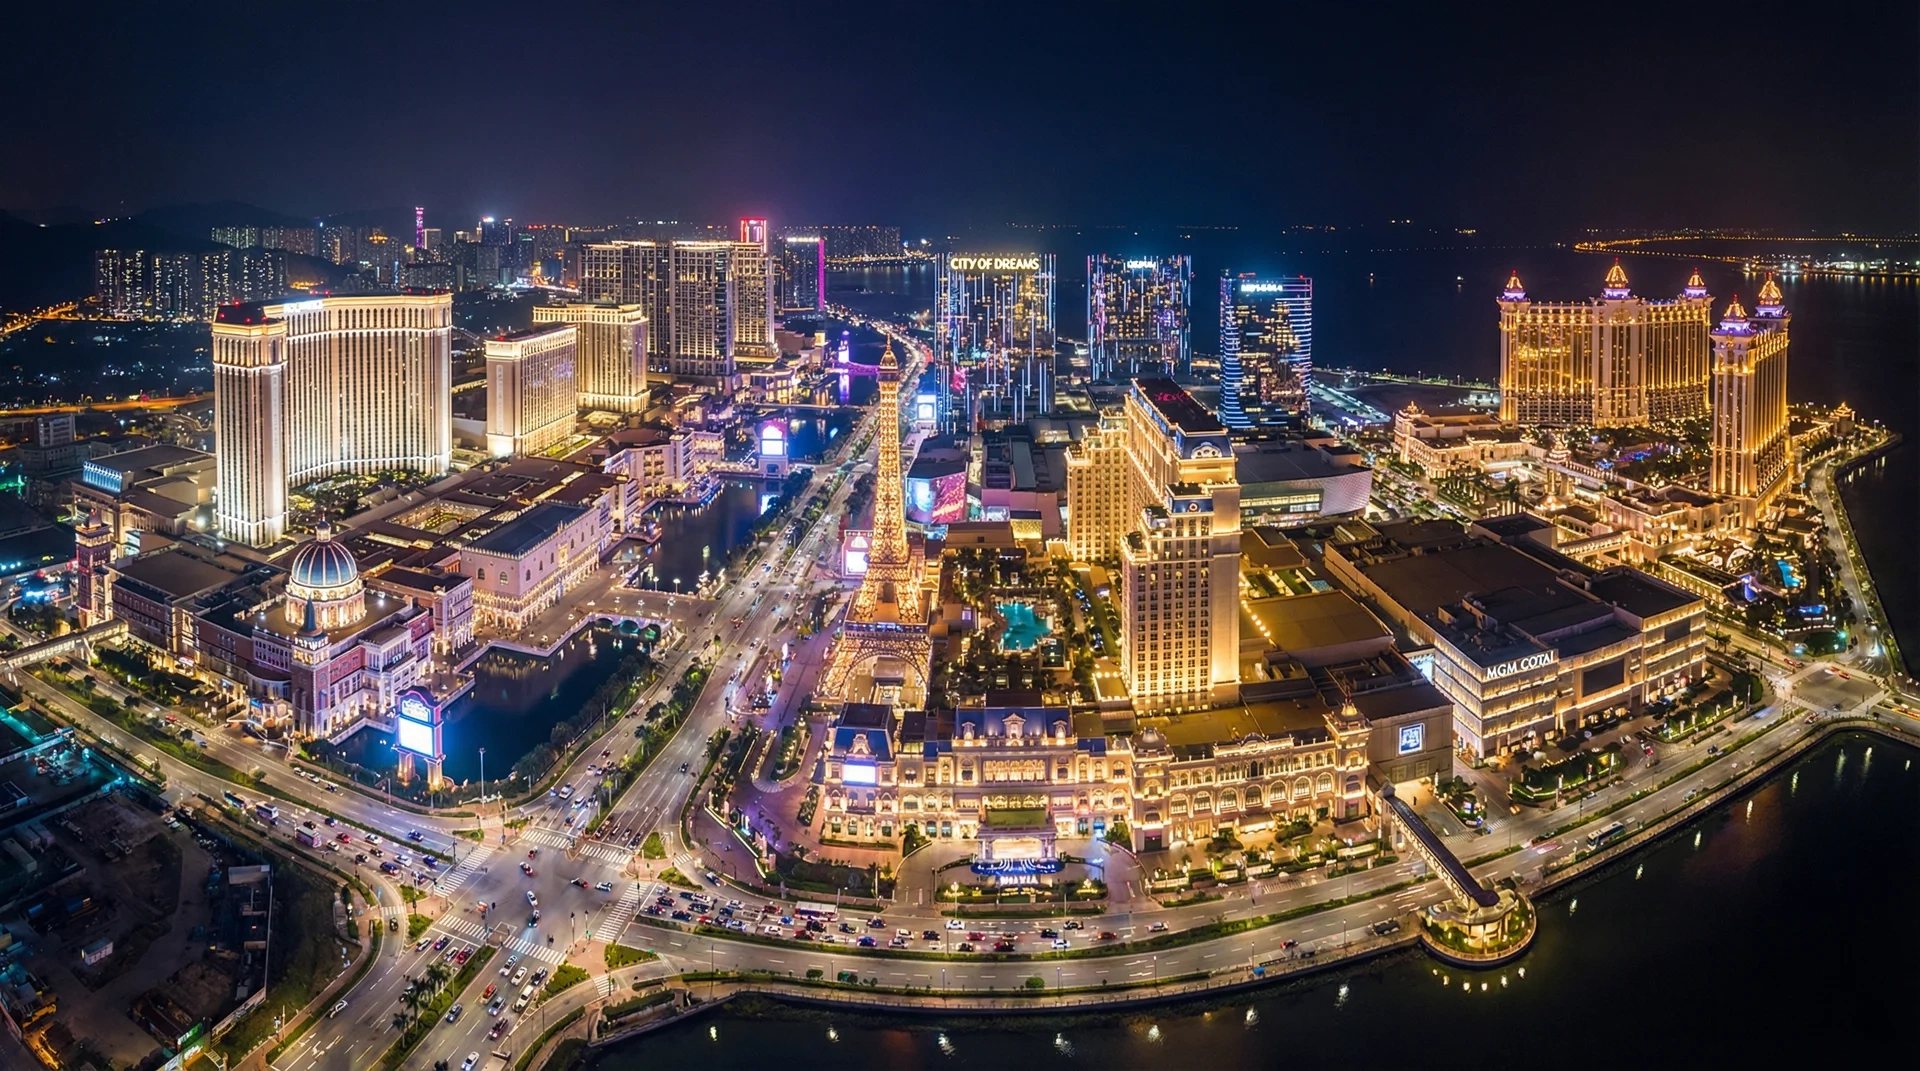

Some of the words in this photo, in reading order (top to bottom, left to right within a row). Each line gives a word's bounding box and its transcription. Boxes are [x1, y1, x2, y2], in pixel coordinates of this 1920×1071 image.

[950, 258, 976, 270] CITY
[977, 258, 993, 270] OF
[994, 258, 1040, 270] DREAMS
[1486, 661, 1517, 680] MGM
[1521, 650, 1554, 670] COTAI
